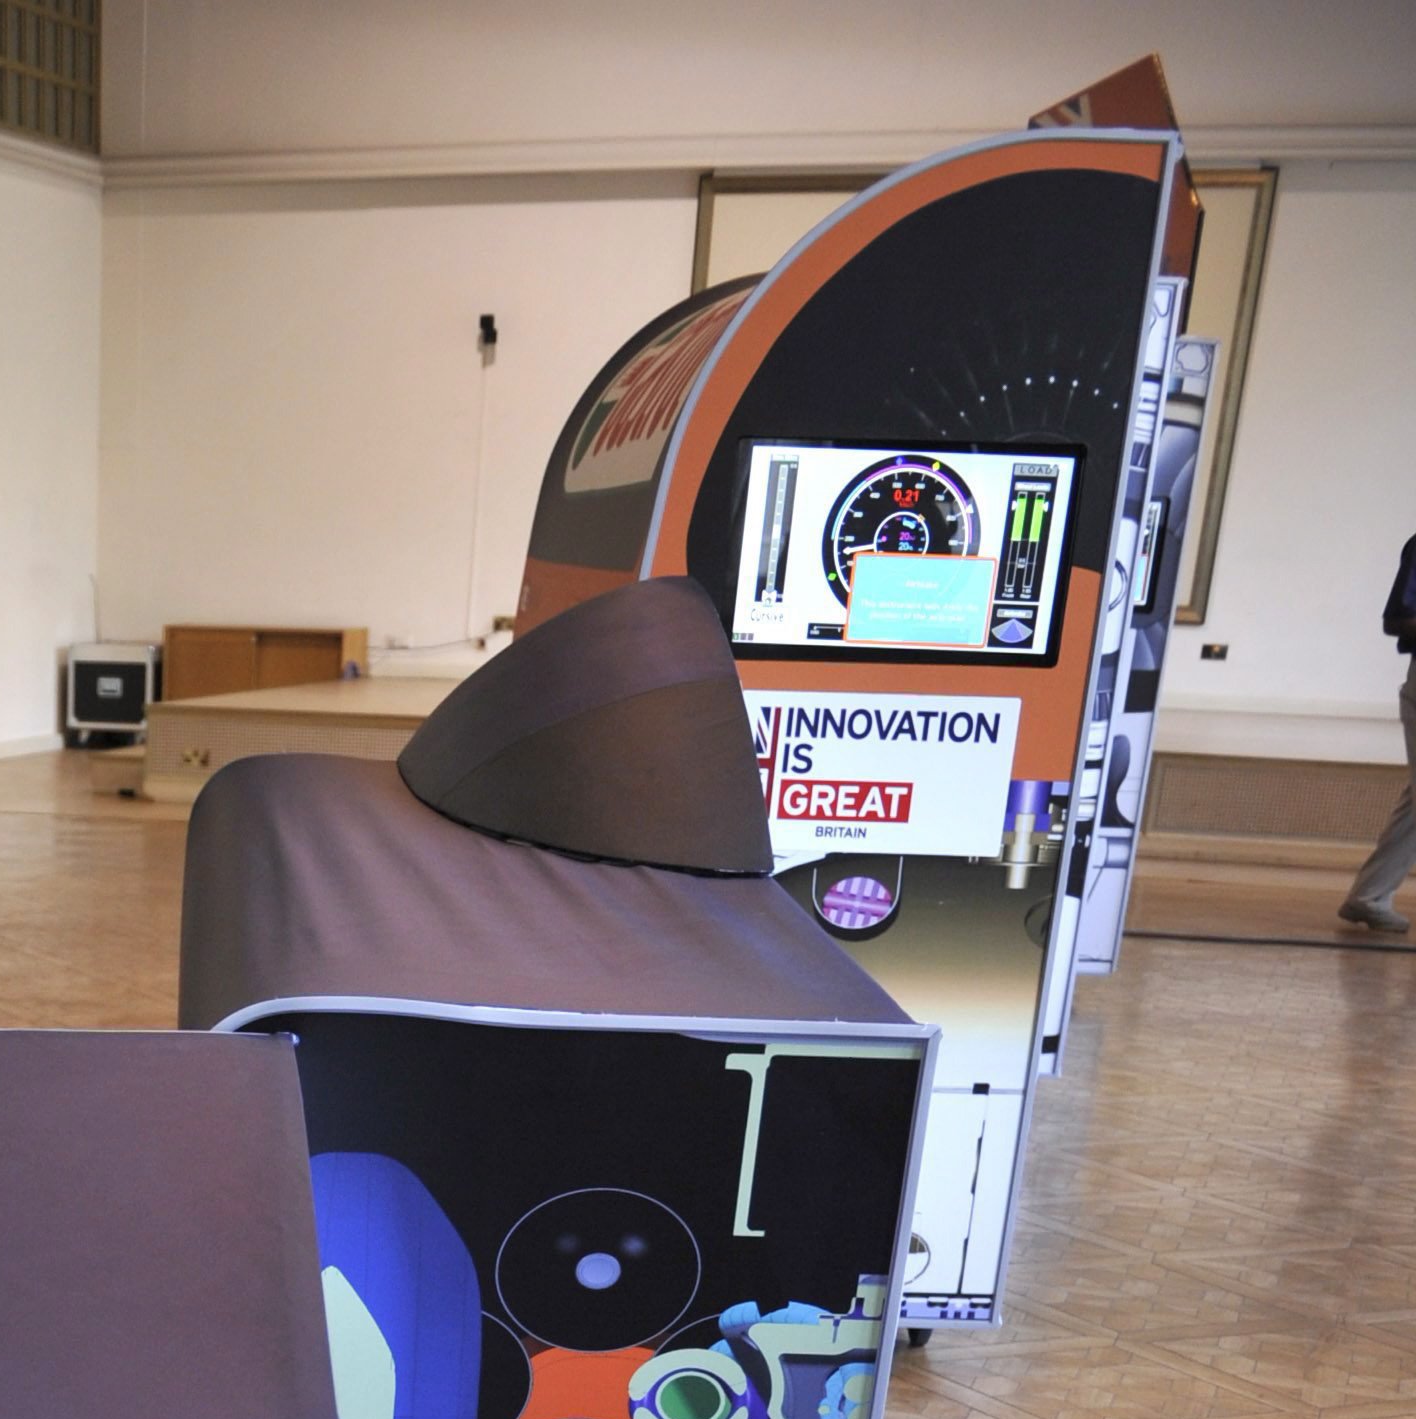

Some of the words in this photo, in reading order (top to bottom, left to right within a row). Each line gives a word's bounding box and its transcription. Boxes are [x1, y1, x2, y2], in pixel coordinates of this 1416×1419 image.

[1020, 465, 1053, 475] LOAD
[893, 488, 920, 502] 0.21
[785, 706, 1001, 744] INNOVATION
[781, 743, 814, 774] IS
[782, 783, 909, 819] GREAT
[815, 826, 867, 839] BRITAIN
